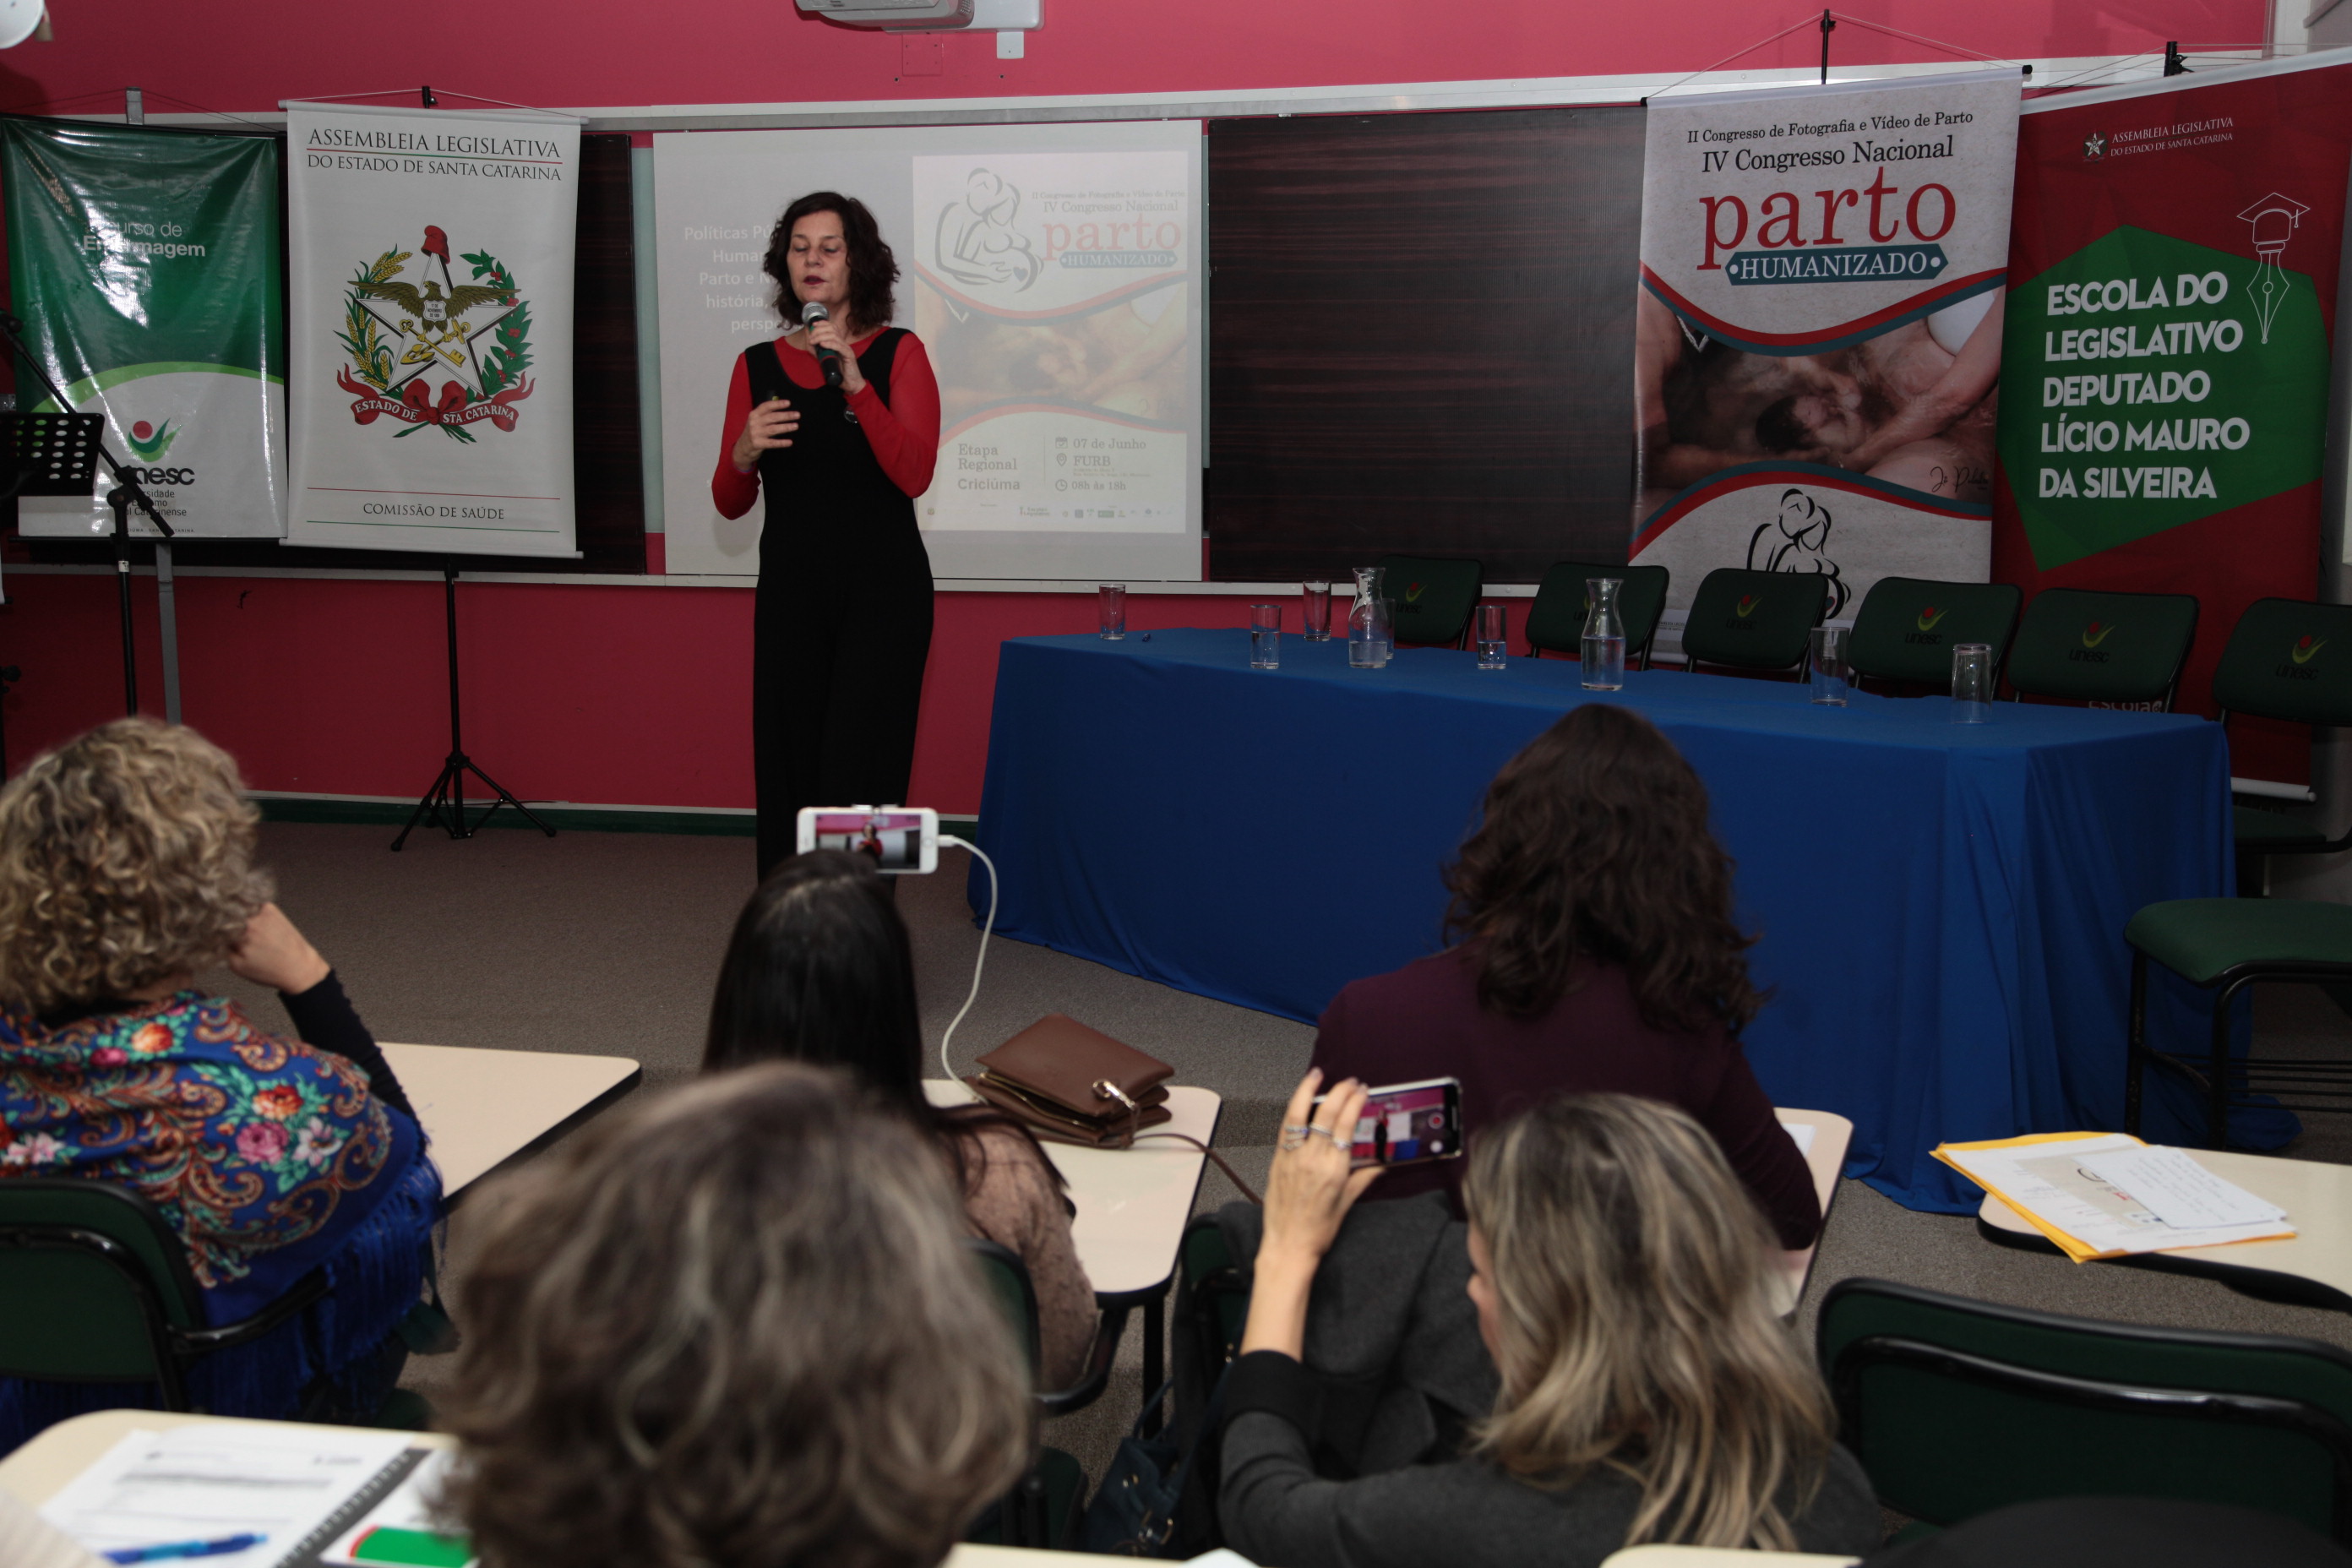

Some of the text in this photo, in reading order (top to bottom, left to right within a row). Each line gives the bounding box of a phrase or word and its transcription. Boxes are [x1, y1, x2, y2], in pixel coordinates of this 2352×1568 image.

[1688, 112, 1974, 144] II Congresso de Fotografia e Vídeo de Parto
[2112, 117, 2234, 144] ASSEMBLEIA LEGISLATIVA
[308, 128, 561, 158] ASSEMBLEIA LEGISLATIVA
[2110, 133, 2233, 156] DO ESTADO DE SANTA CATARINA
[1701, 134, 1953, 173] IV Congresso Nacional
[308, 155, 562, 181] DO ESTADO DE SANTA CATARINA
[1043, 200, 1178, 215] IV Congresso Nacional
[1696, 166, 1957, 270] parto
[112, 220, 182, 237] urso de
[684, 226, 748, 241] Políticas
[1042, 213, 1181, 261] parto
[1068, 253, 1168, 265] HUMANIZADO
[1740, 252, 1927, 280] HUMANIZADO
[700, 272, 741, 286] Parto
[745, 274, 754, 284] e
[706, 293, 768, 309] história,
[2047, 271, 2228, 316] ESCOLA DO
[2044, 318, 2244, 362] LEGISLATIVO
[2043, 369, 2211, 407] DEPUTADO
[354, 400, 400, 414] ESTADO
[402, 409, 417, 421] DE
[466, 406, 514, 421] CATARINA
[2040, 412, 2251, 453] LÍCIO MAURO
[957, 444, 999, 457] Etapa
[1073, 438, 1146, 449] 07 de Junho
[957, 458, 1018, 472] Regional
[1073, 455, 1111, 466] FURB
[134, 467, 195, 485] nesc
[2039, 466, 2218, 498] DA SILVEIRA
[1071, 481, 1090, 490] 08h
[1108, 481, 1126, 490] 18h
[363, 504, 504, 520] COMISSÃO DE SAÚDE
[1905, 632, 1942, 645] unesc
[2069, 649, 2110, 663] unesc
[2276, 664, 2319, 680] unesc
